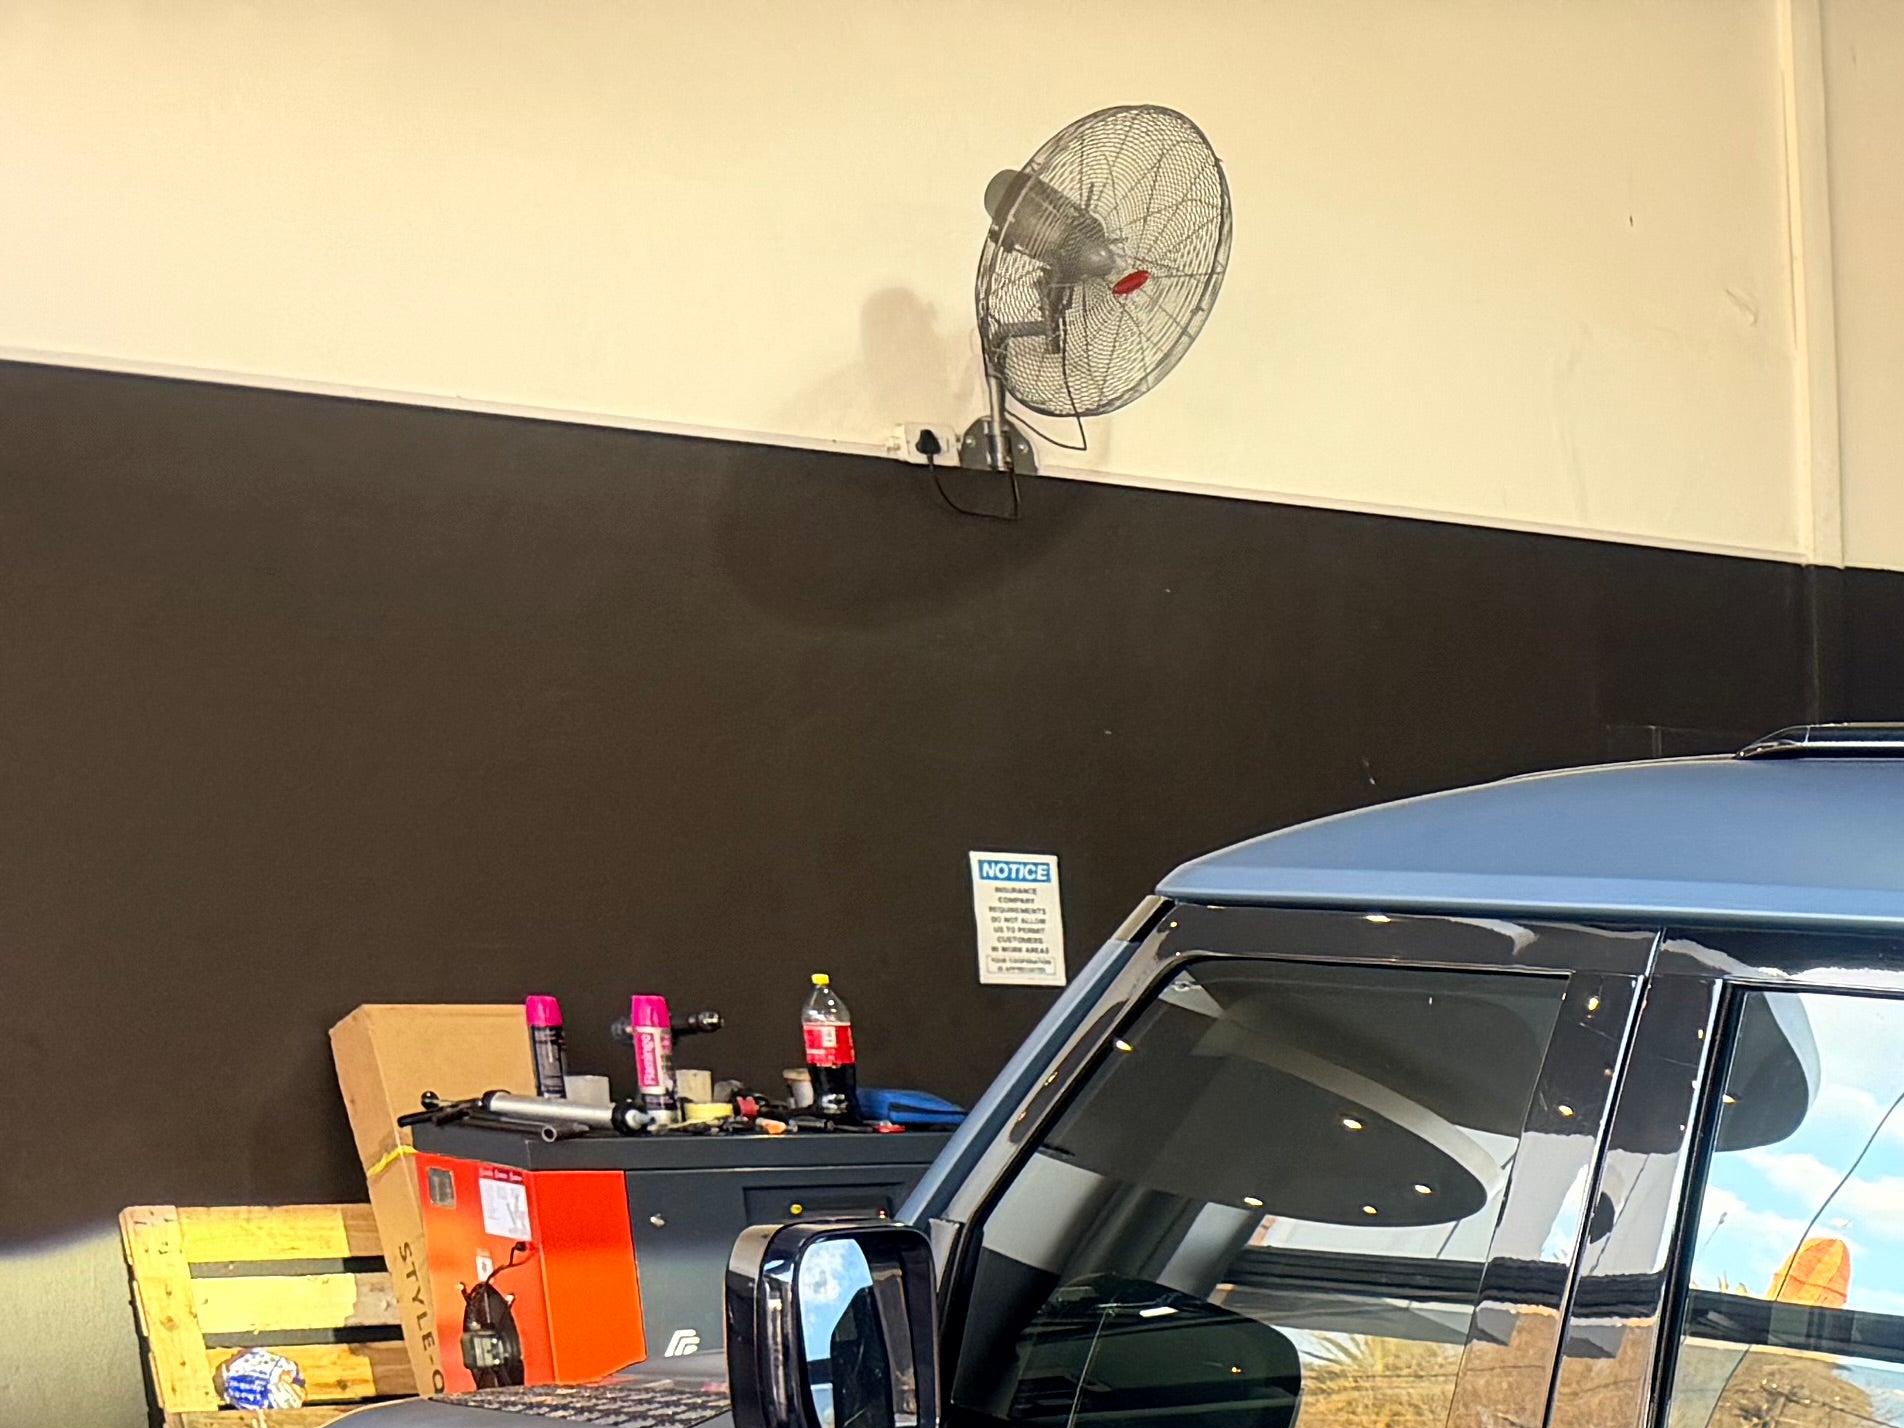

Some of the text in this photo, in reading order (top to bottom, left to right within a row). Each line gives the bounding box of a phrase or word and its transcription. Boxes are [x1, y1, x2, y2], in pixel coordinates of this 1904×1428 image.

[982, 862, 1049, 880] NOTICE
[995, 887, 1037, 895] INSURANCE
[998, 896, 1035, 904] COMPANY
[988, 906, 1046, 915] REQUIREMENTS
[1004, 916, 1018, 924] NOT
[1006, 926, 1016, 934] TO
[1017, 926, 1046, 934] PERMIT
[996, 936, 1044, 944] CUSTOMERS
[640, 1033, 657, 1086] Flamingo
